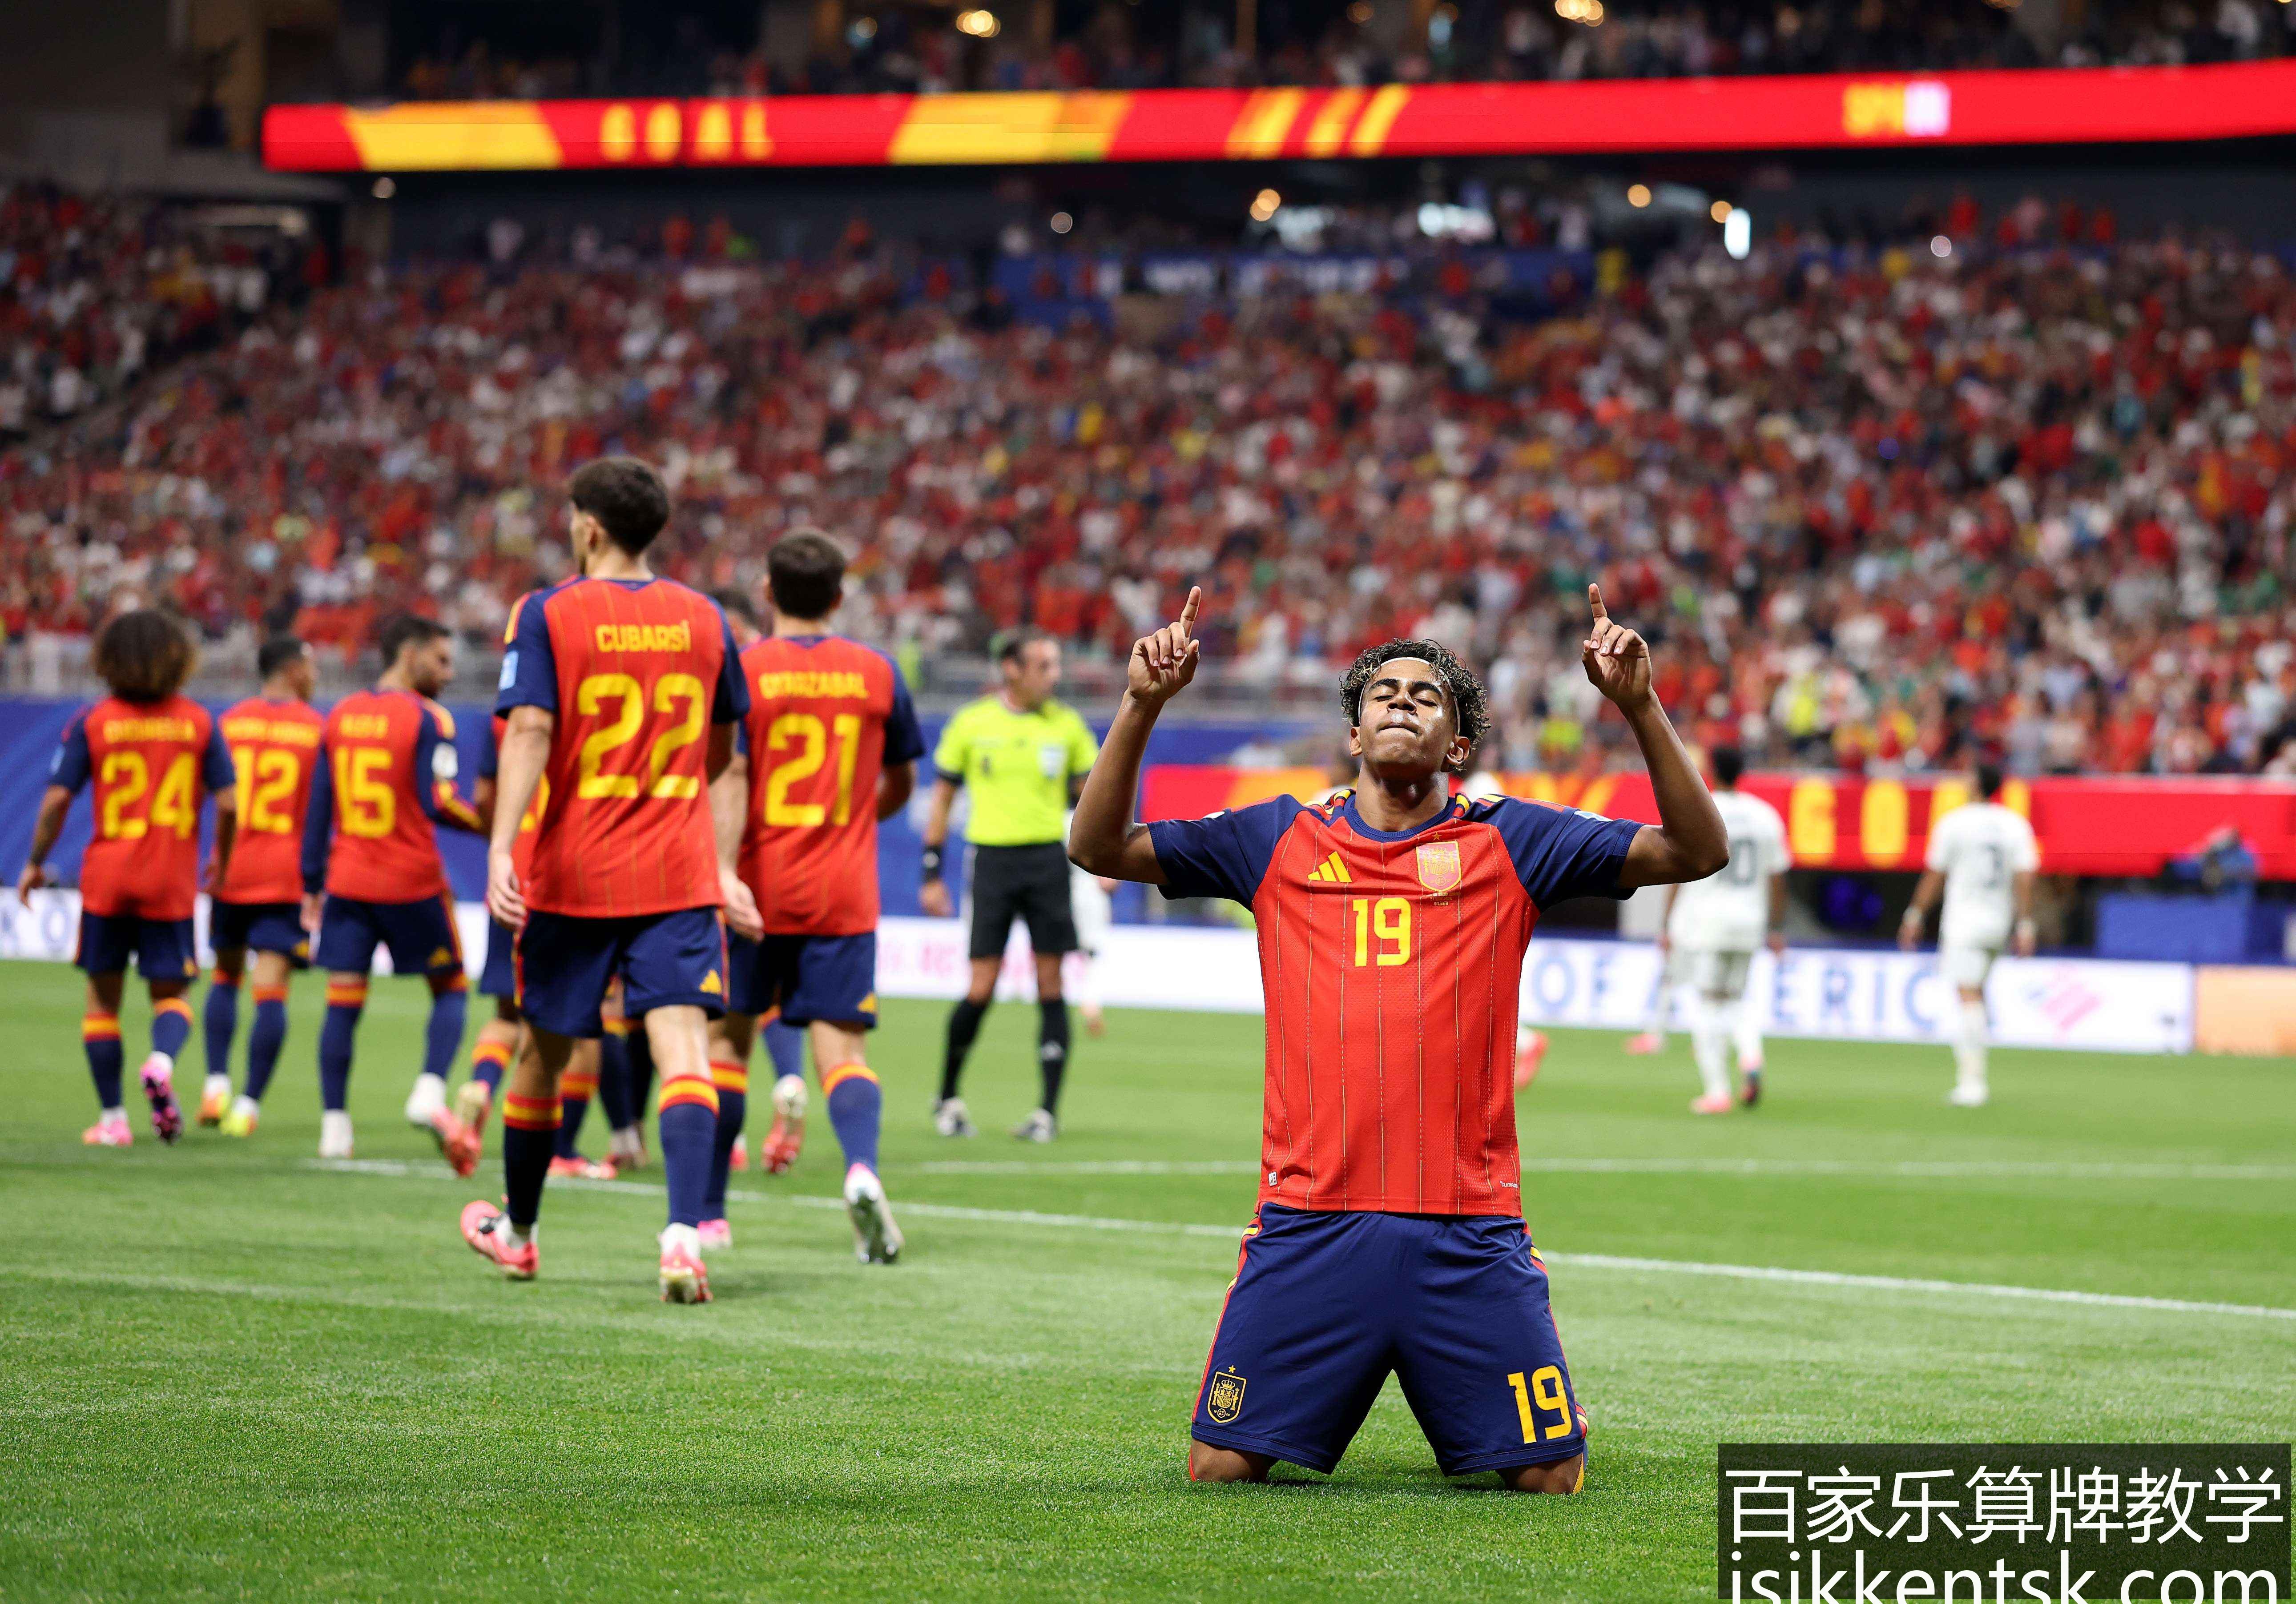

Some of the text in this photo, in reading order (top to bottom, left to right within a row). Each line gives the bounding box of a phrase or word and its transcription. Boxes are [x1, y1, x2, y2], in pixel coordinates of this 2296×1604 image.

[579, 673, 705, 800] 22
[765, 713, 862, 827] 21
[101, 750, 197, 840] 24
[232, 745, 300, 835] 12
[334, 744, 396, 839] 15
[1353, 897, 1411, 967] 19
[1508, 1364, 1573, 1444] 19
